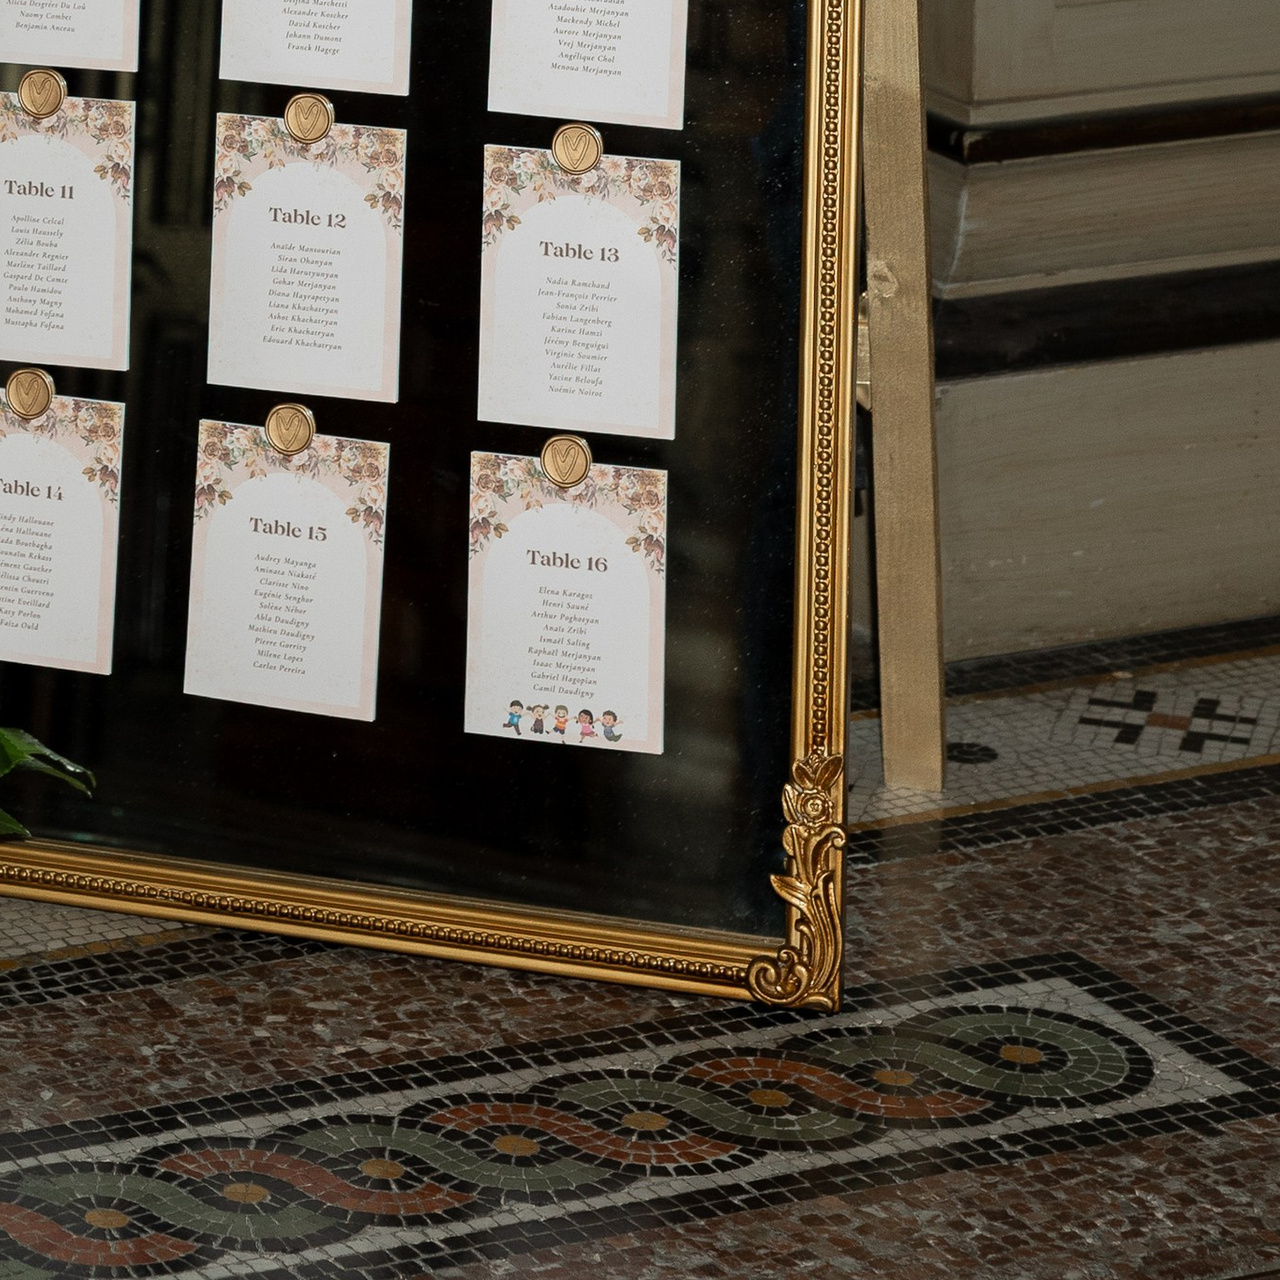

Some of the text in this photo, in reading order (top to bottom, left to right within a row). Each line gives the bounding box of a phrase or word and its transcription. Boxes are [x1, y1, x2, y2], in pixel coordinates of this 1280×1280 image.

[282, 7, 318, 17] Alexandre
[589, 7, 629, 18] Merjanyan
[15, 22, 48, 31] Benjamin
[558, 52, 595, 62] Angélique
[4, 180, 74, 200] Table 11
[268, 207, 347, 229] Table 12
[4, 248, 69, 262] Alexandre Regnier
[539, 241, 620, 263] Table 13
[37, 263, 67, 272] Taillard
[300, 257, 333, 268] Ohanyan
[271, 266, 339, 280] Lida Harutyunyan
[546, 277, 568, 286] Nadia
[5, 307, 38, 316] Mohamed
[556, 302, 599, 312] Sonia Zribi
[542, 312, 612, 328] Fabian Langenberg
[270, 324, 335, 339] Eric Khachatryan
[46, 485, 64, 501] 14
[249, 517, 328, 542] Table 15
[256, 554, 281, 565] Audrey
[526, 549, 608, 573] Table 16
[254, 589, 314, 604] Eugénie Senghor
[538, 586, 593, 600] Elena Karagoz
[252, 661, 306, 675] Carlos Pereira
[530, 672, 597, 686] Gabriel Hagopian
[533, 684, 595, 699] Camil Daudigny
